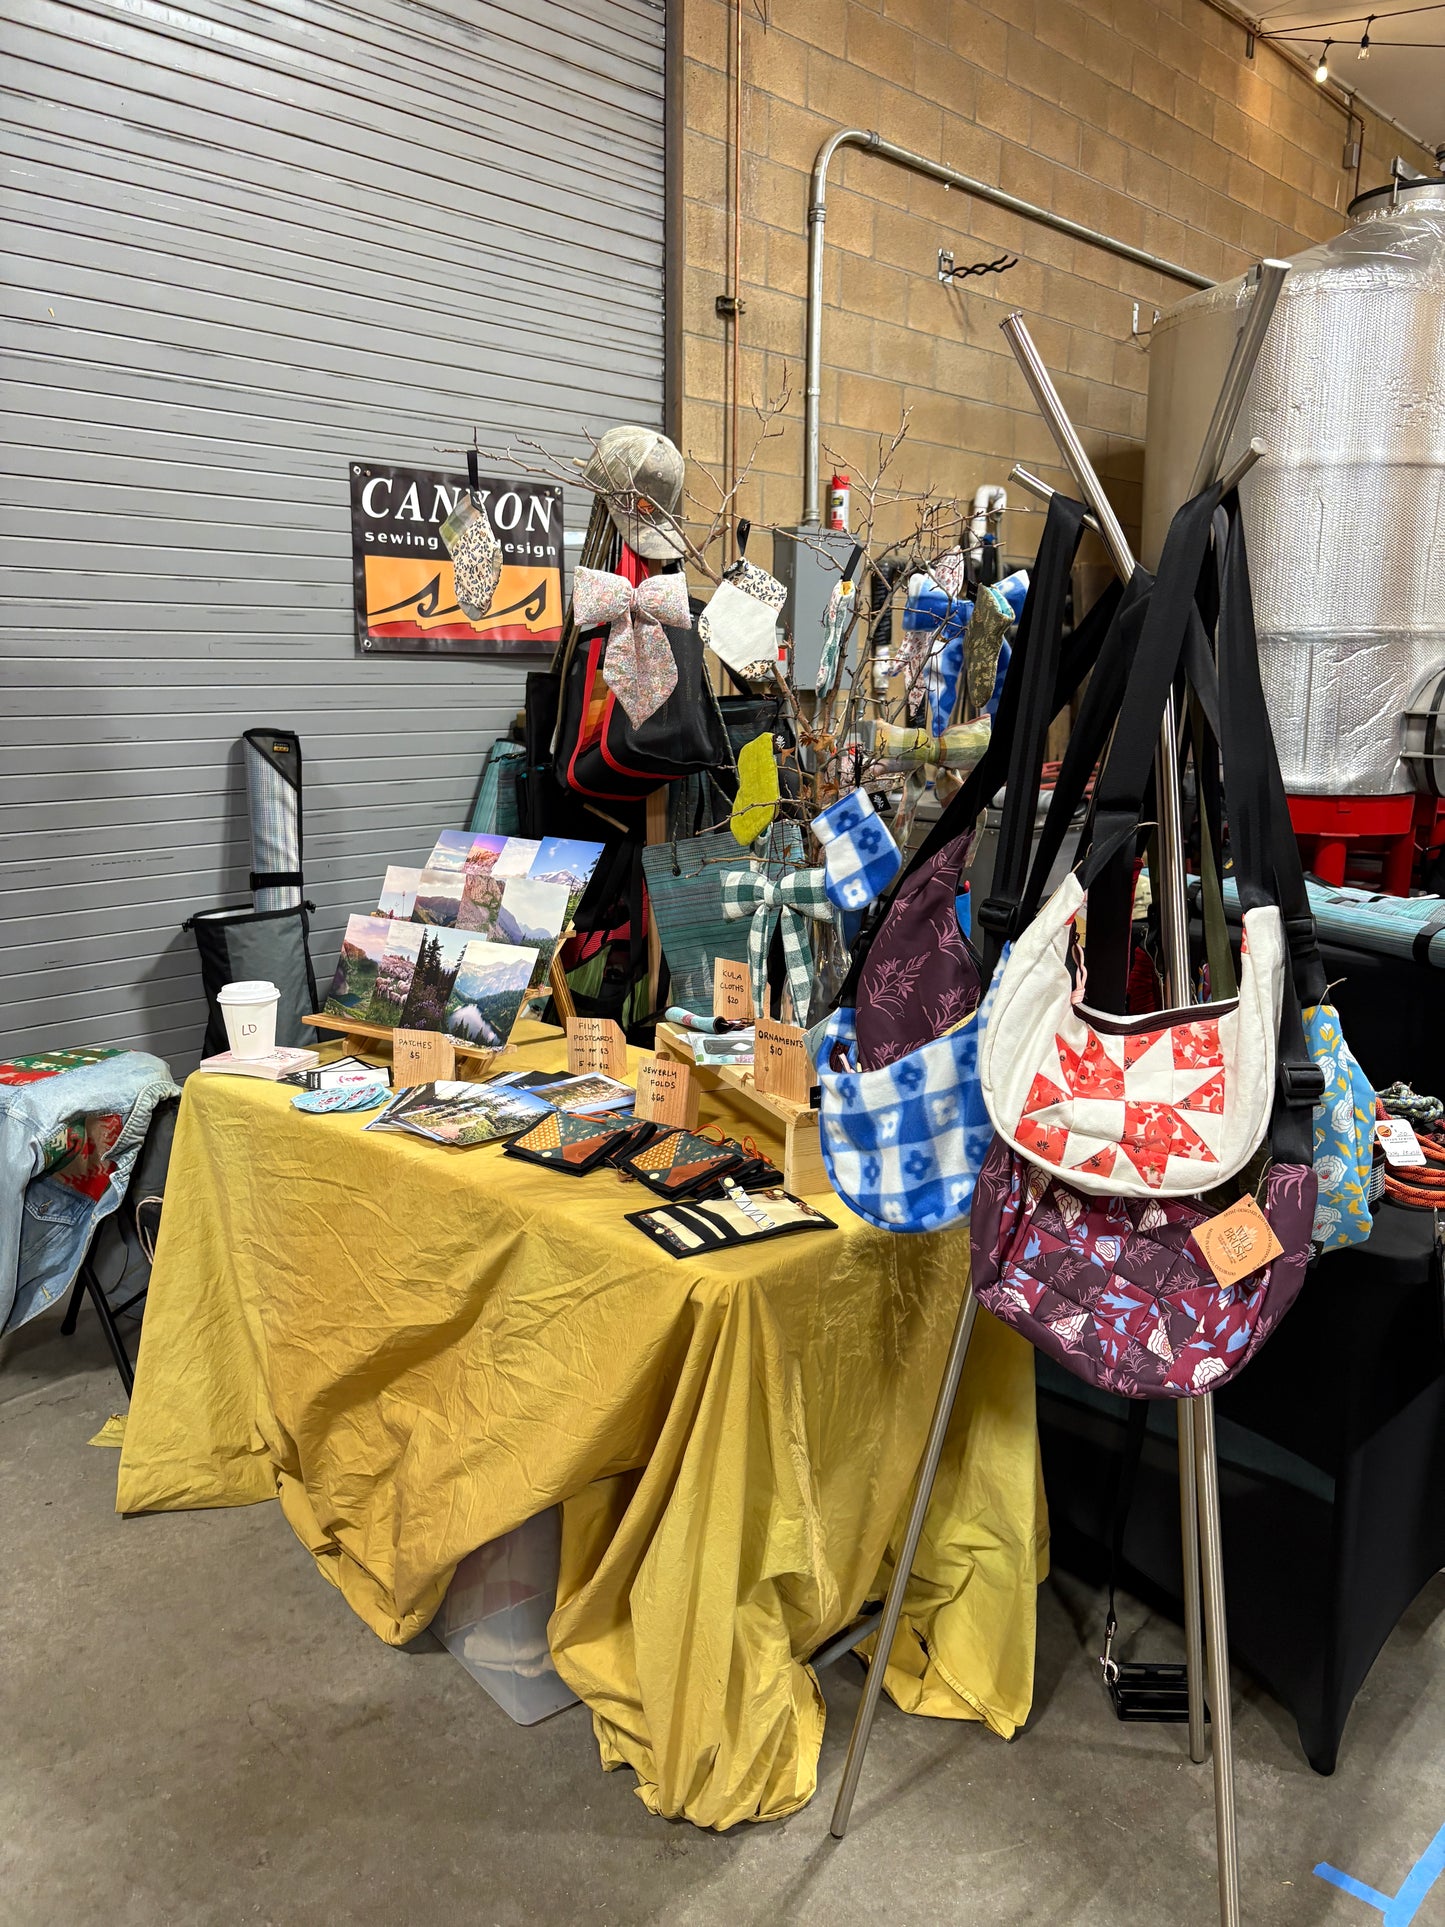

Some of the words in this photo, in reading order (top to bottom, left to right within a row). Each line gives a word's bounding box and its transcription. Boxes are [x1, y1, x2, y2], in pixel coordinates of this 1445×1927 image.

[364, 531, 439, 550] sewing
[722, 969, 743, 981] KULA
[720, 982, 744, 993] CLOTHS
[727, 996, 739, 1005] $20
[578, 1022, 600, 1031] FILM
[398, 1038, 432, 1050] PATCHES
[573, 1034, 614, 1043] POSTCARDS
[758, 1030, 804, 1049] ORNAMENTS
[410, 1050, 420, 1060] $5
[769, 1045, 783, 1056] $10
[643, 1066, 677, 1079] JEWERLY
[650, 1079, 676, 1089] FOLDS
[1234, 1224, 1254, 1252] WILD
[1223, 1227, 1248, 1262] BRUSH
